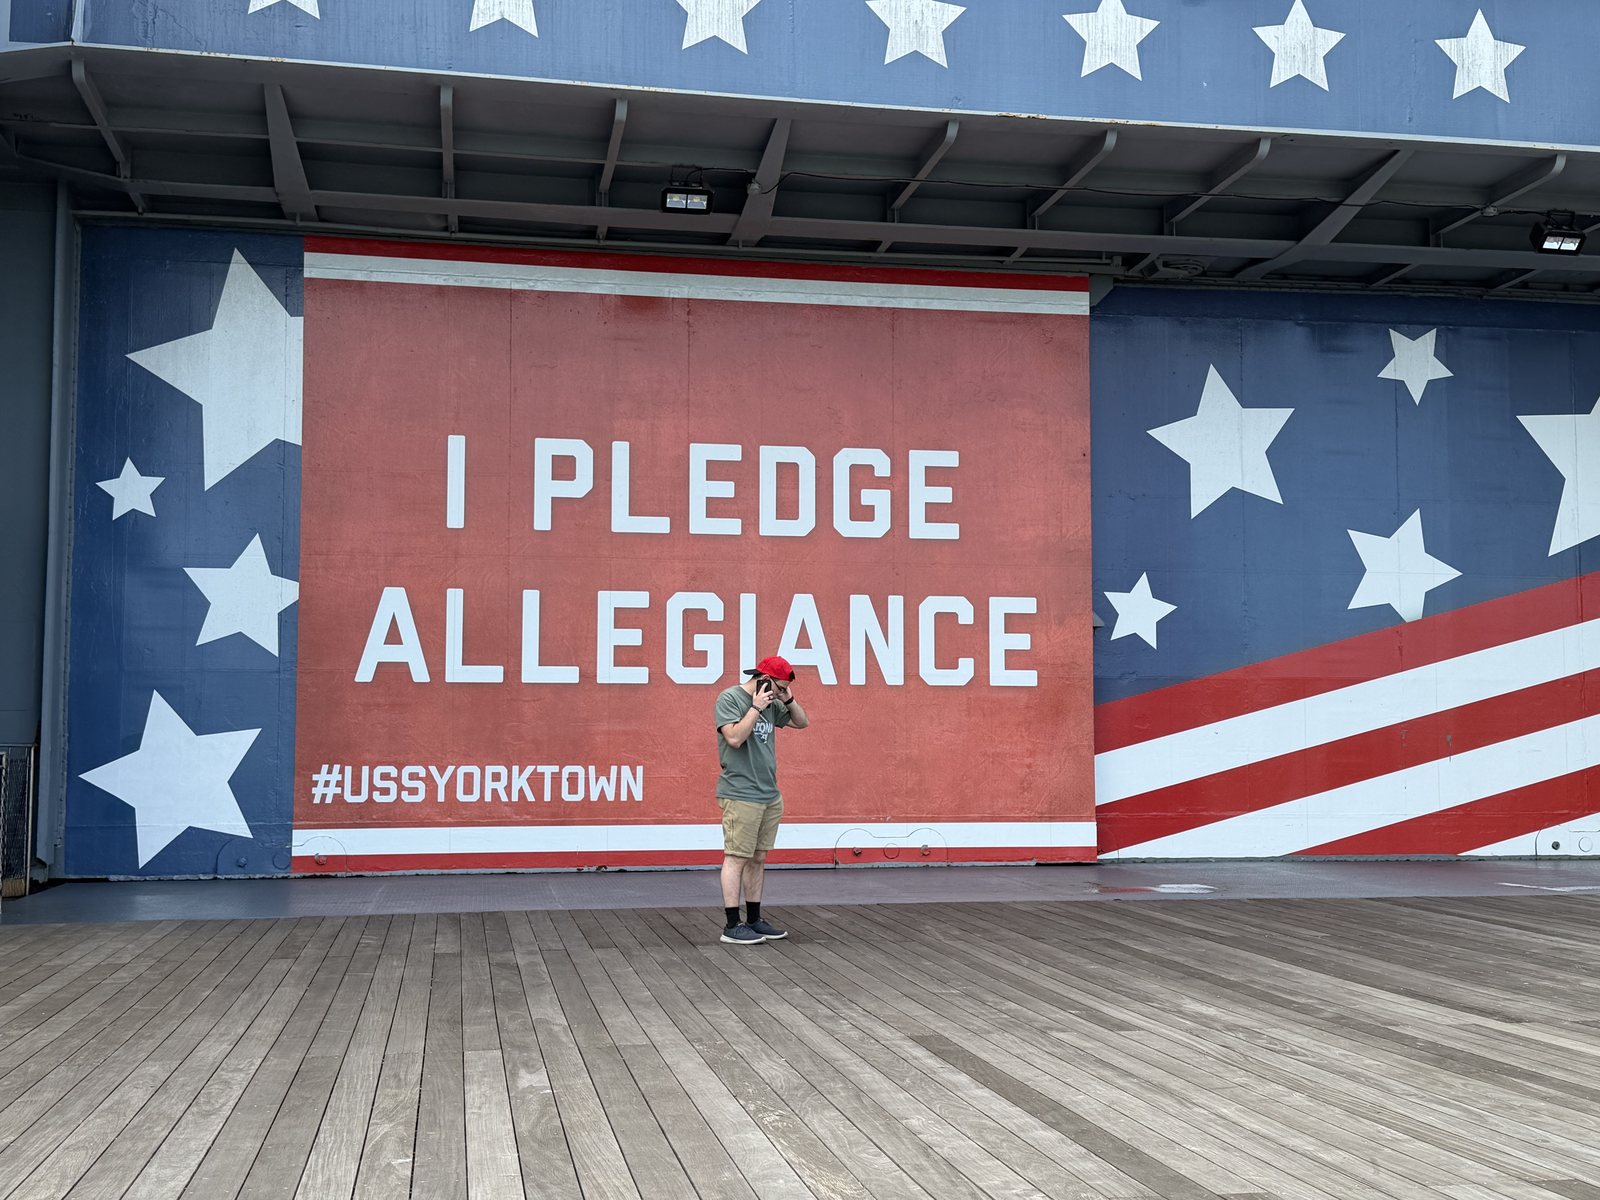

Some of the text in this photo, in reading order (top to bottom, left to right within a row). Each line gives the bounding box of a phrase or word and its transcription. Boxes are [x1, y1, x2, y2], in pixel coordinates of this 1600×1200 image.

[446, 434, 961, 541] I PLEDGE
[354, 586, 1039, 688] ALLEGIANCE
[311, 764, 645, 804] #USSYORKTOWN
